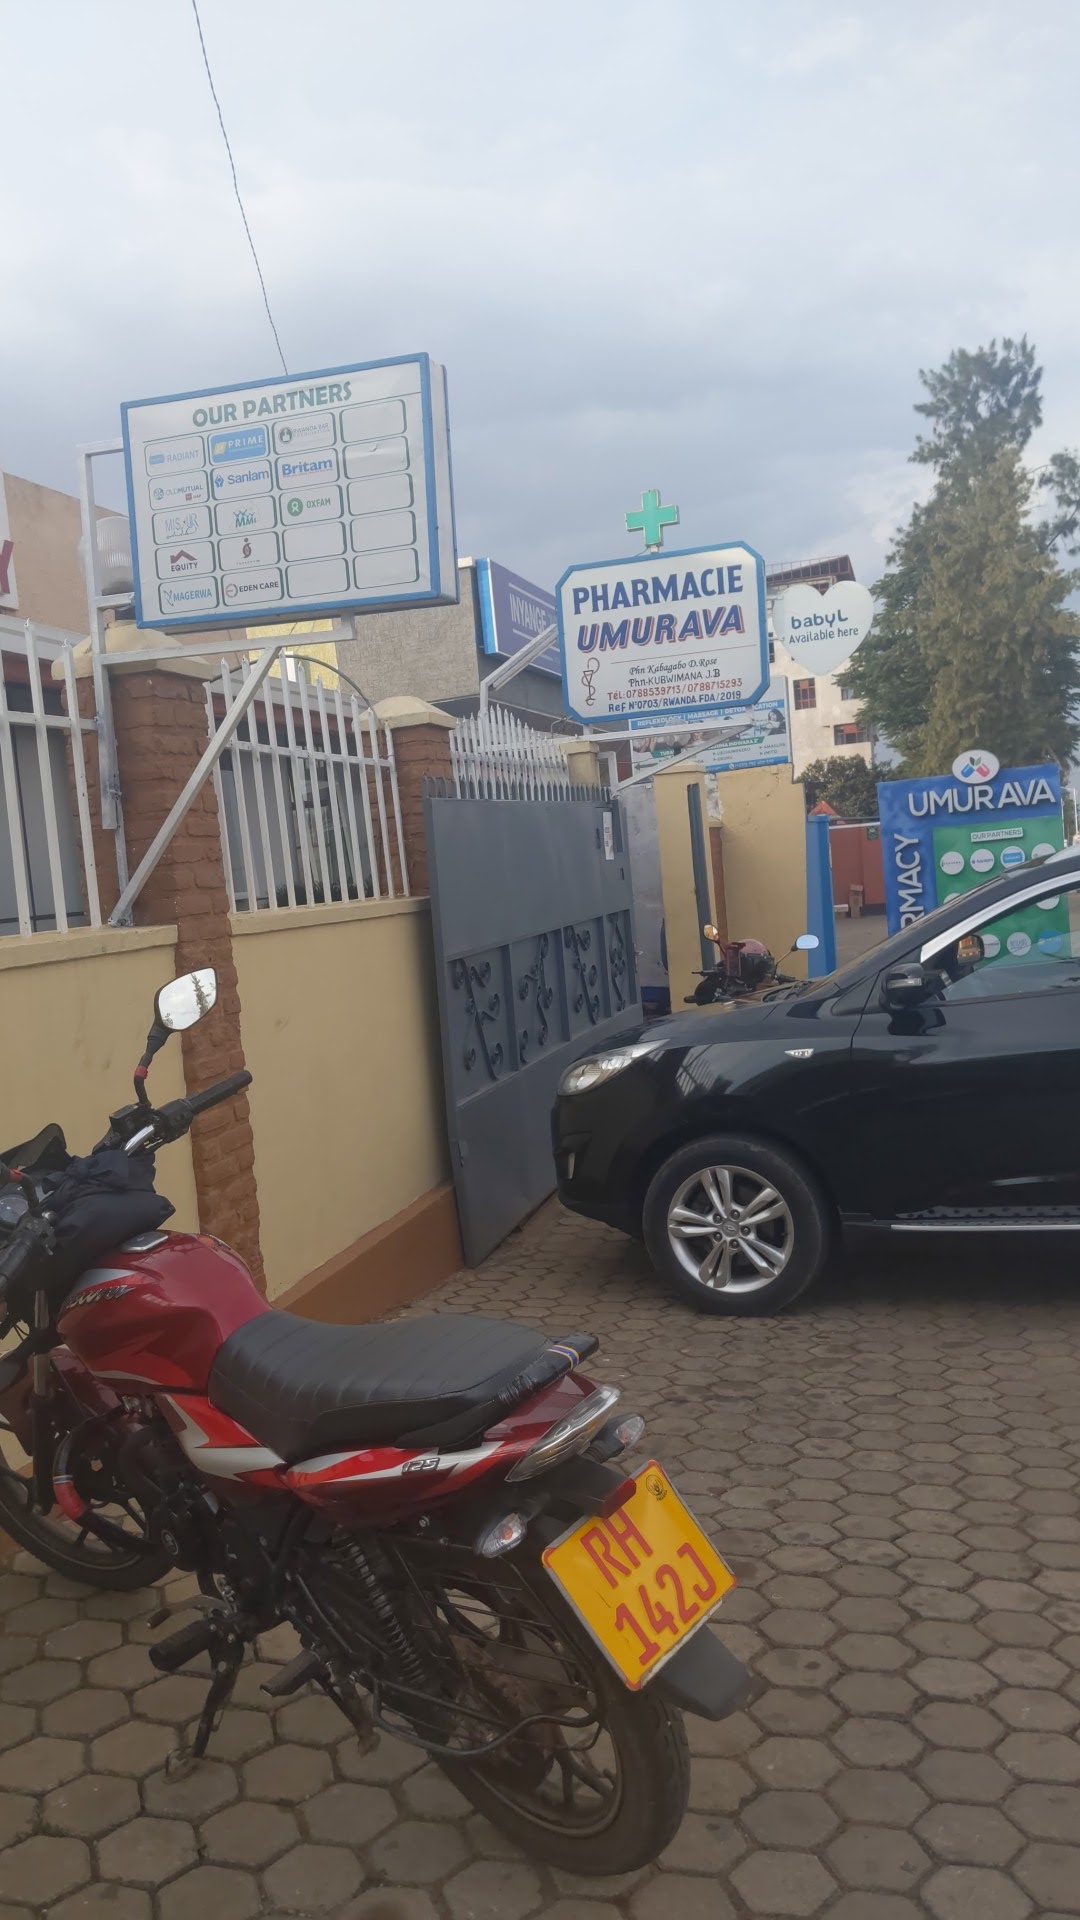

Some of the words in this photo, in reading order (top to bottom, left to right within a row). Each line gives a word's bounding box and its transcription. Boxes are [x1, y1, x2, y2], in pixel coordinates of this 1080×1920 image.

[192, 403, 238, 428] OUR
[243, 381, 352, 419] PARTNERS
[228, 434, 265, 448] PRIME
[166, 449, 200, 463] RADIANT
[281, 459, 333, 475] Britam
[227, 470, 270, 485] Sanlam
[306, 497, 331, 509] OXFAM
[170, 562, 198, 572] EQUITY
[239, 584, 259, 592] EDEN
[259, 581, 279, 590] CARE
[572, 564, 743, 615] PHARMACIE
[173, 588, 213, 602] MAGERWA
[509, 593, 548, 634] INYANGE
[577, 604, 745, 653] UMURAVA
[788, 629, 835, 645] Available
[837, 626, 859, 638] here
[629, 666, 646, 675] Phn
[647, 661, 687, 674] Kabagabo
[687, 709, 719, 720] MASSAGE
[908, 778, 1056, 817] UMURAVA
[972, 832, 987, 840] OUR
[987, 829, 1022, 838] PARTNERS
[402, 1457, 440, 1473] 125
[580, 1507, 653, 1589] RH
[615, 1542, 717, 1666] 142J
